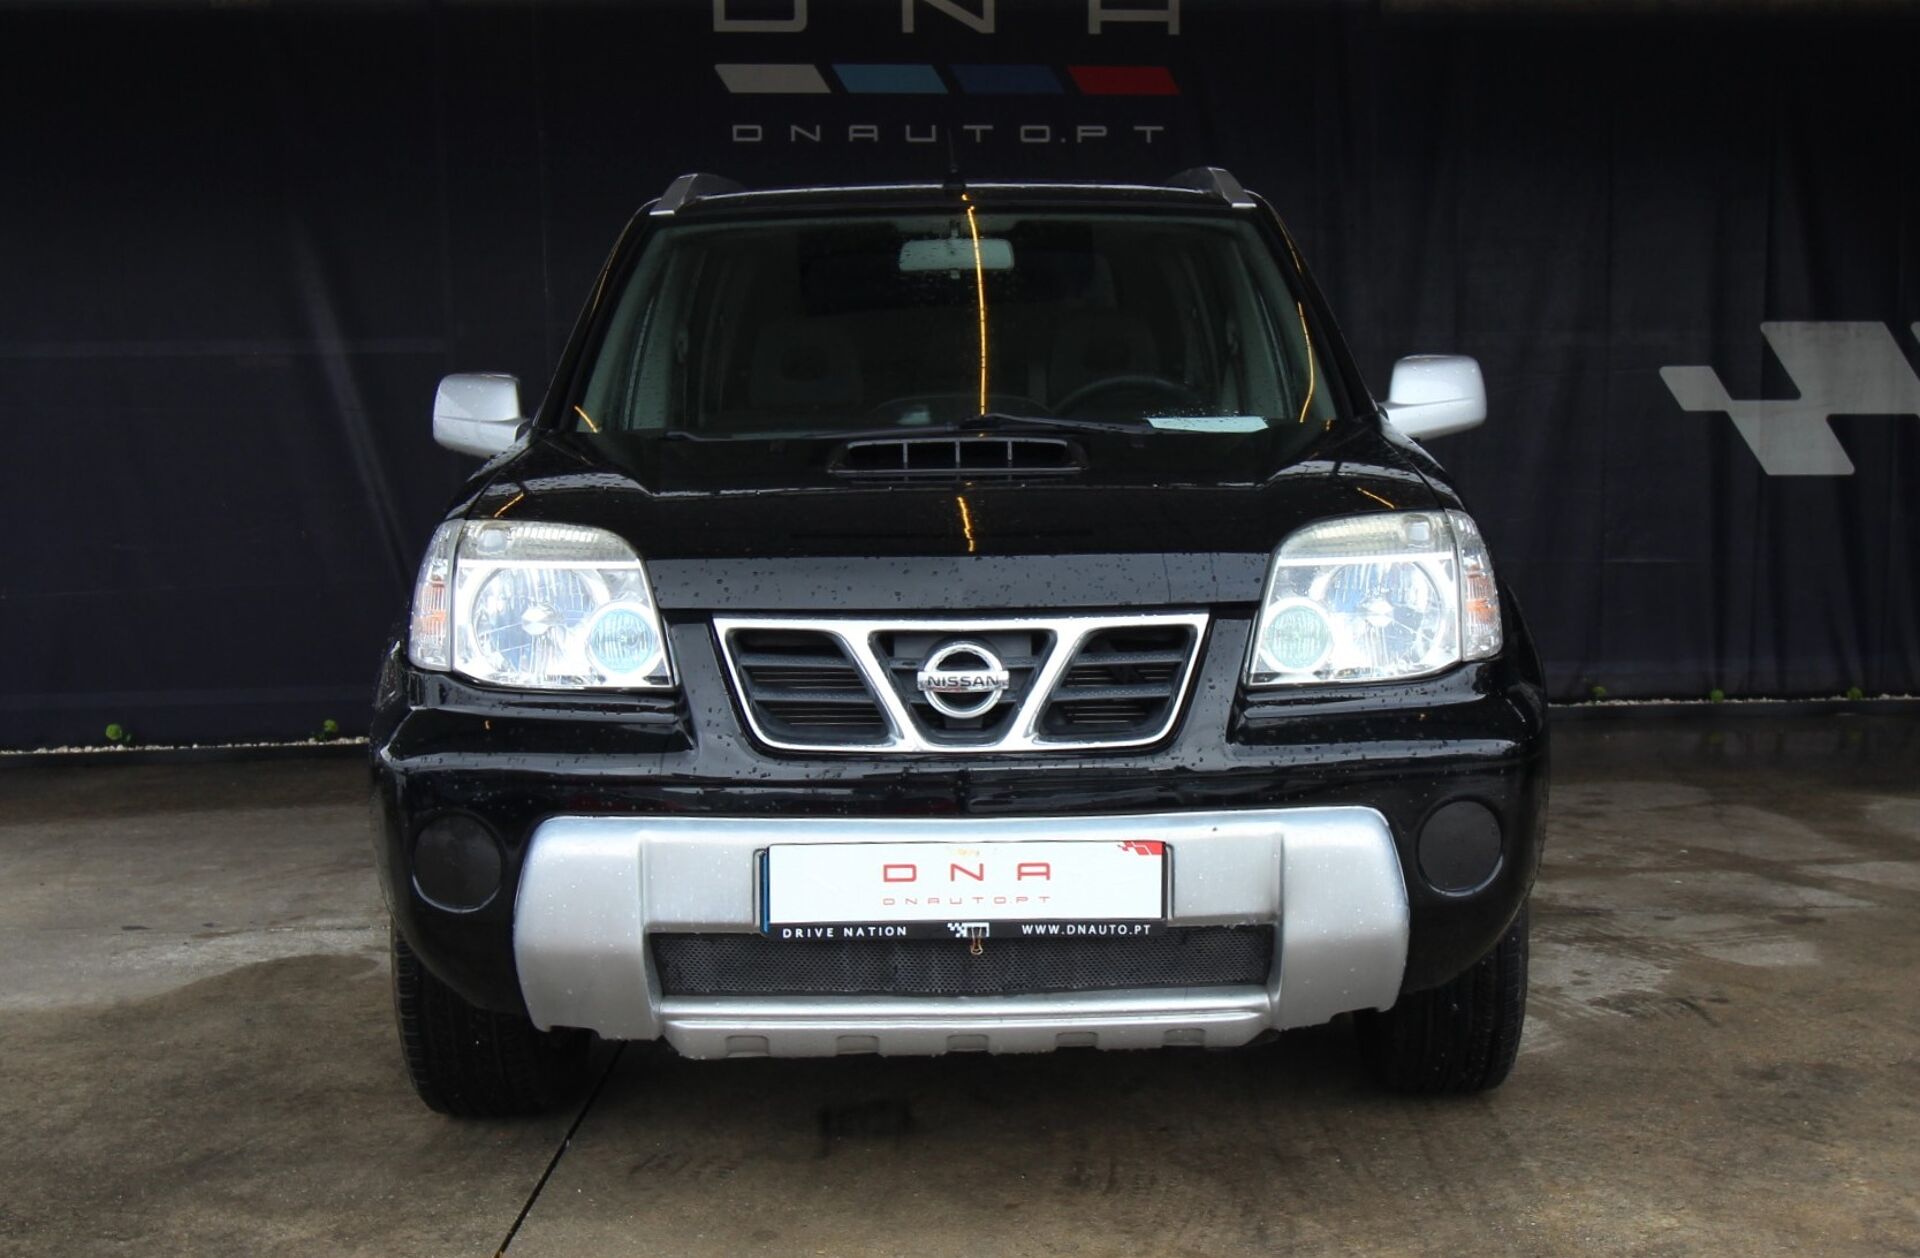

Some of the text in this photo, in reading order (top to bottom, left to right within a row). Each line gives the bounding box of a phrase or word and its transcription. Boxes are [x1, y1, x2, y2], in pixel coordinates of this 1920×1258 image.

[732, 124, 1165, 143] DNAUTO.PT
[927, 676, 999, 687] NISSAN
[883, 862, 1051, 882] DNA
[882, 896, 1051, 906] DNAUTO.PT
[782, 925, 908, 939] DRIVE NATION
[1021, 923, 1152, 936] WWW.DNAUTO.PT
